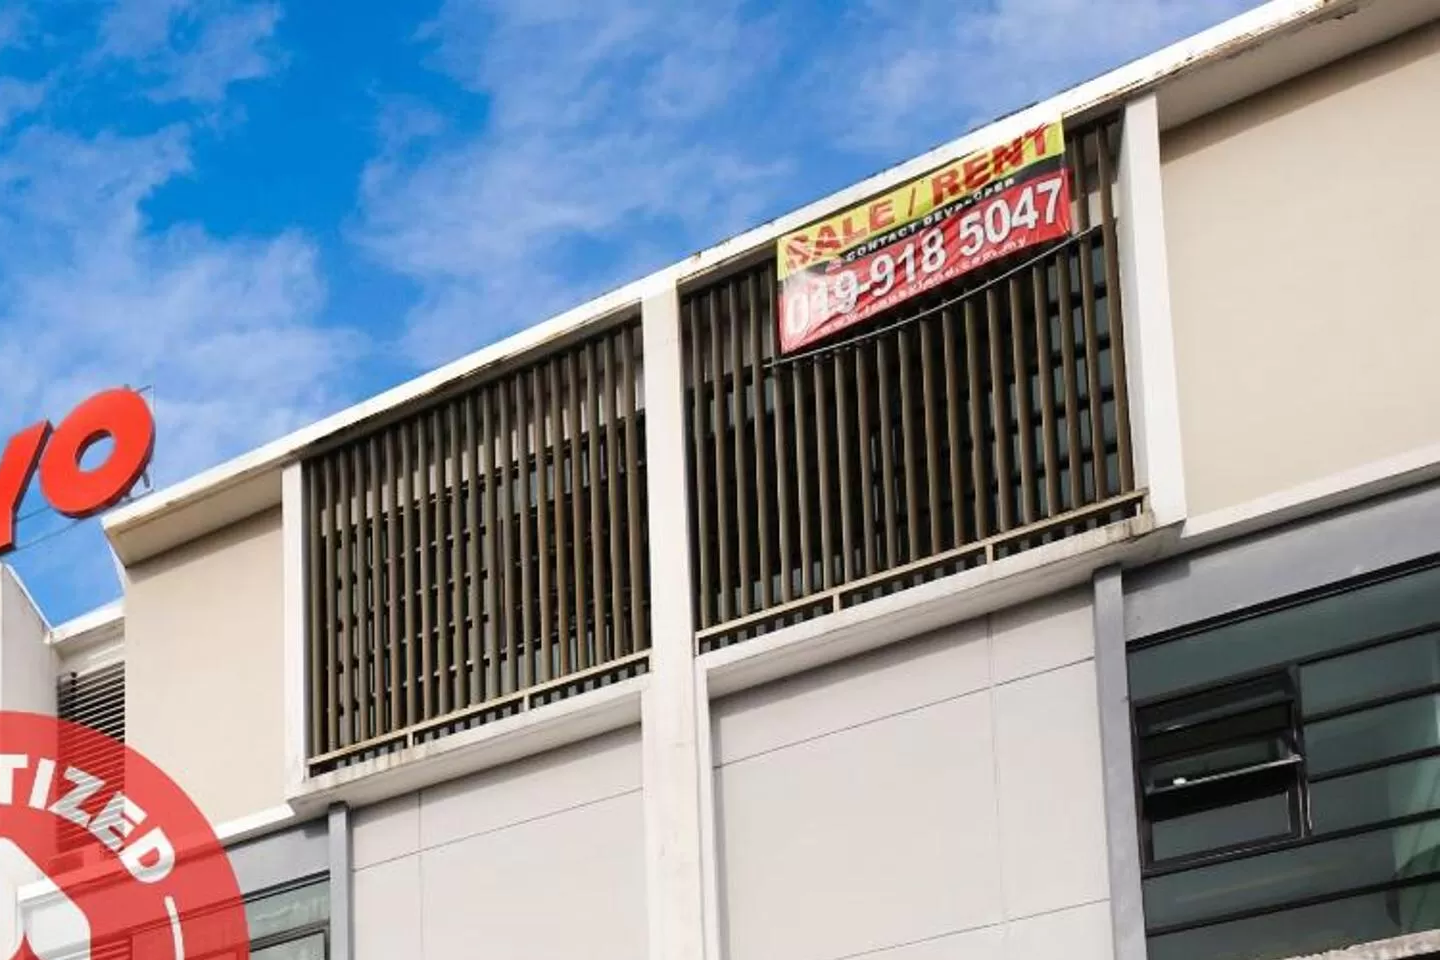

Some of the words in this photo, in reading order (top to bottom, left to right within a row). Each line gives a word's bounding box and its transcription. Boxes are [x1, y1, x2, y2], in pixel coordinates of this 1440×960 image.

[786, 199, 895, 269] SALE
[931, 122, 1053, 205] RENT
[960, 178, 1063, 258] 5047
[846, 222, 917, 262] CONTACT
